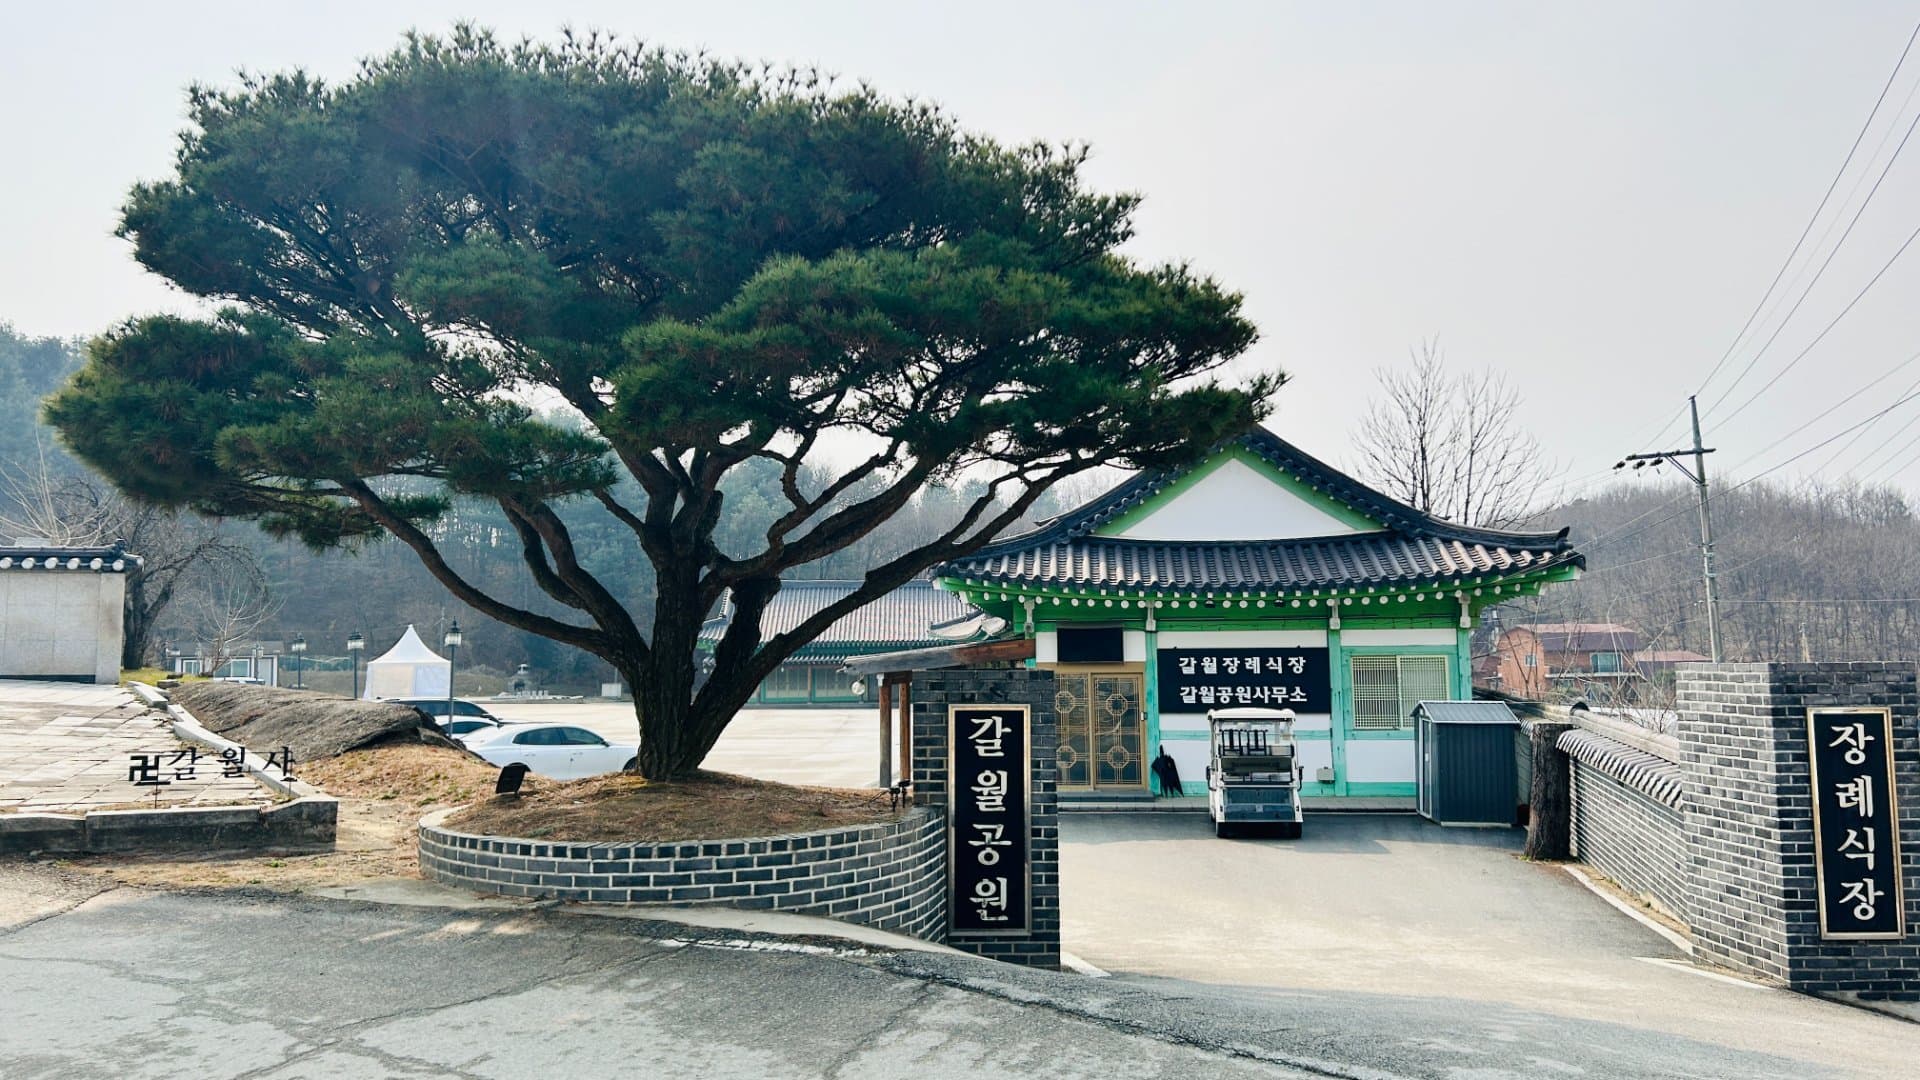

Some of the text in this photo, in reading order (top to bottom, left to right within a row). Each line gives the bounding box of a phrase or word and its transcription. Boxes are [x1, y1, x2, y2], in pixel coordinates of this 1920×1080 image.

[1178, 656, 1306, 674] 갈월장례식장
[1179, 686, 1308, 704] 갈월공원사무소
[968, 715, 1012, 921] 갈월공원
[1829, 723, 1885, 920] 장례식장
